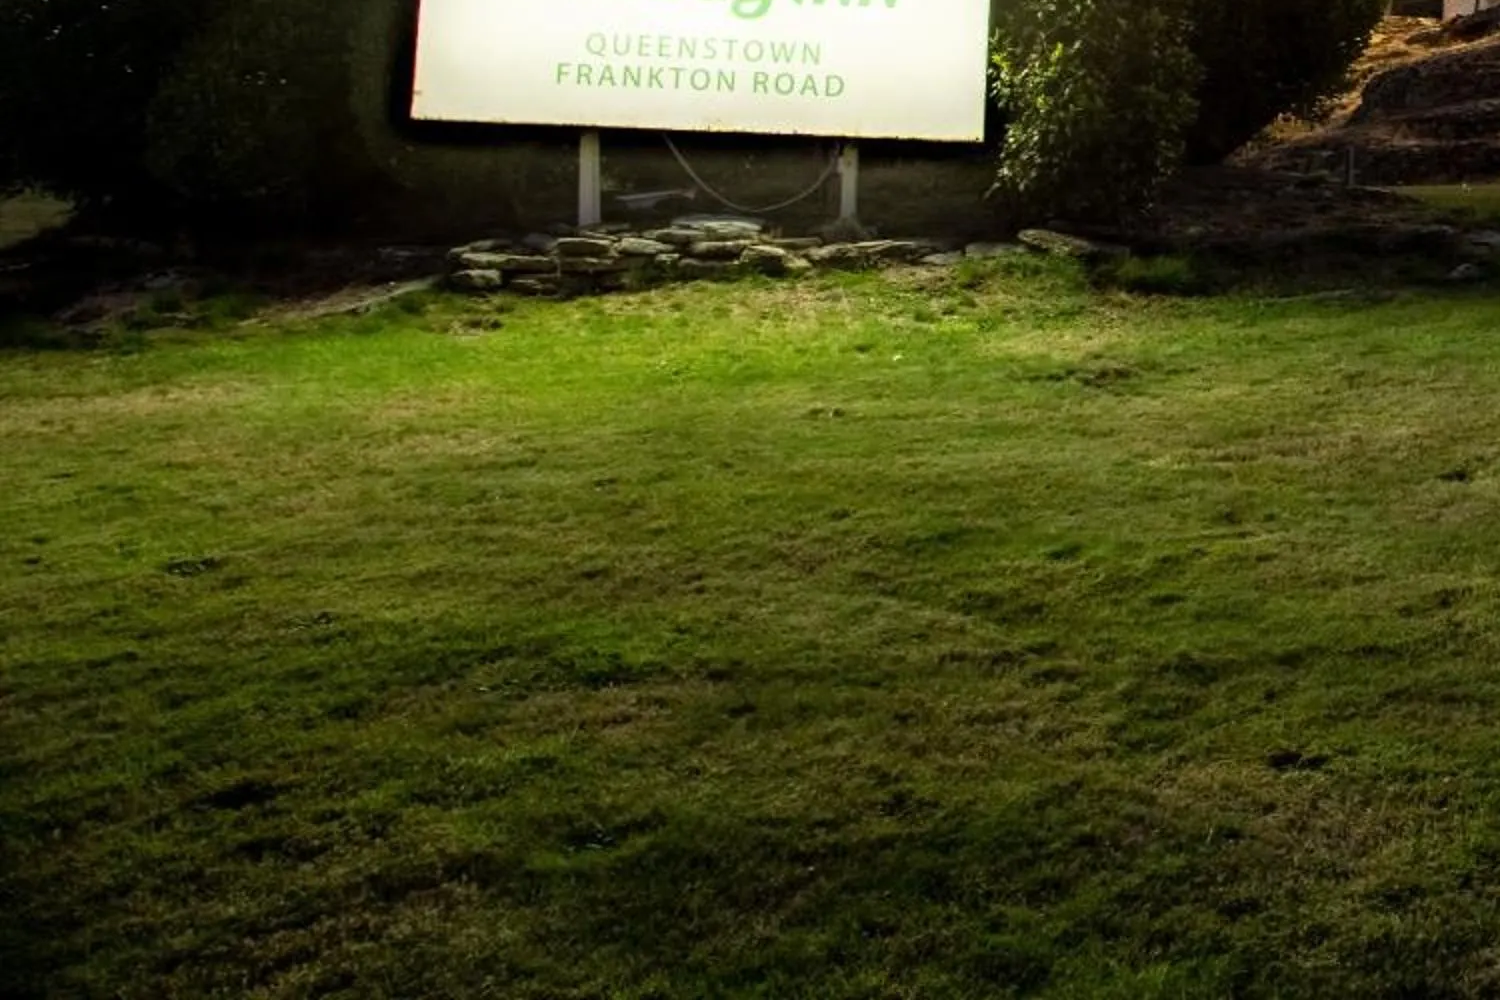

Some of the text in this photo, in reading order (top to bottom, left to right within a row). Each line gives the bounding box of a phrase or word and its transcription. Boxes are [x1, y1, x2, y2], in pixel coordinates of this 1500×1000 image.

[586, 33, 821, 65] QUEENSTOWN
[556, 63, 845, 98] FRANKTON ROAD
